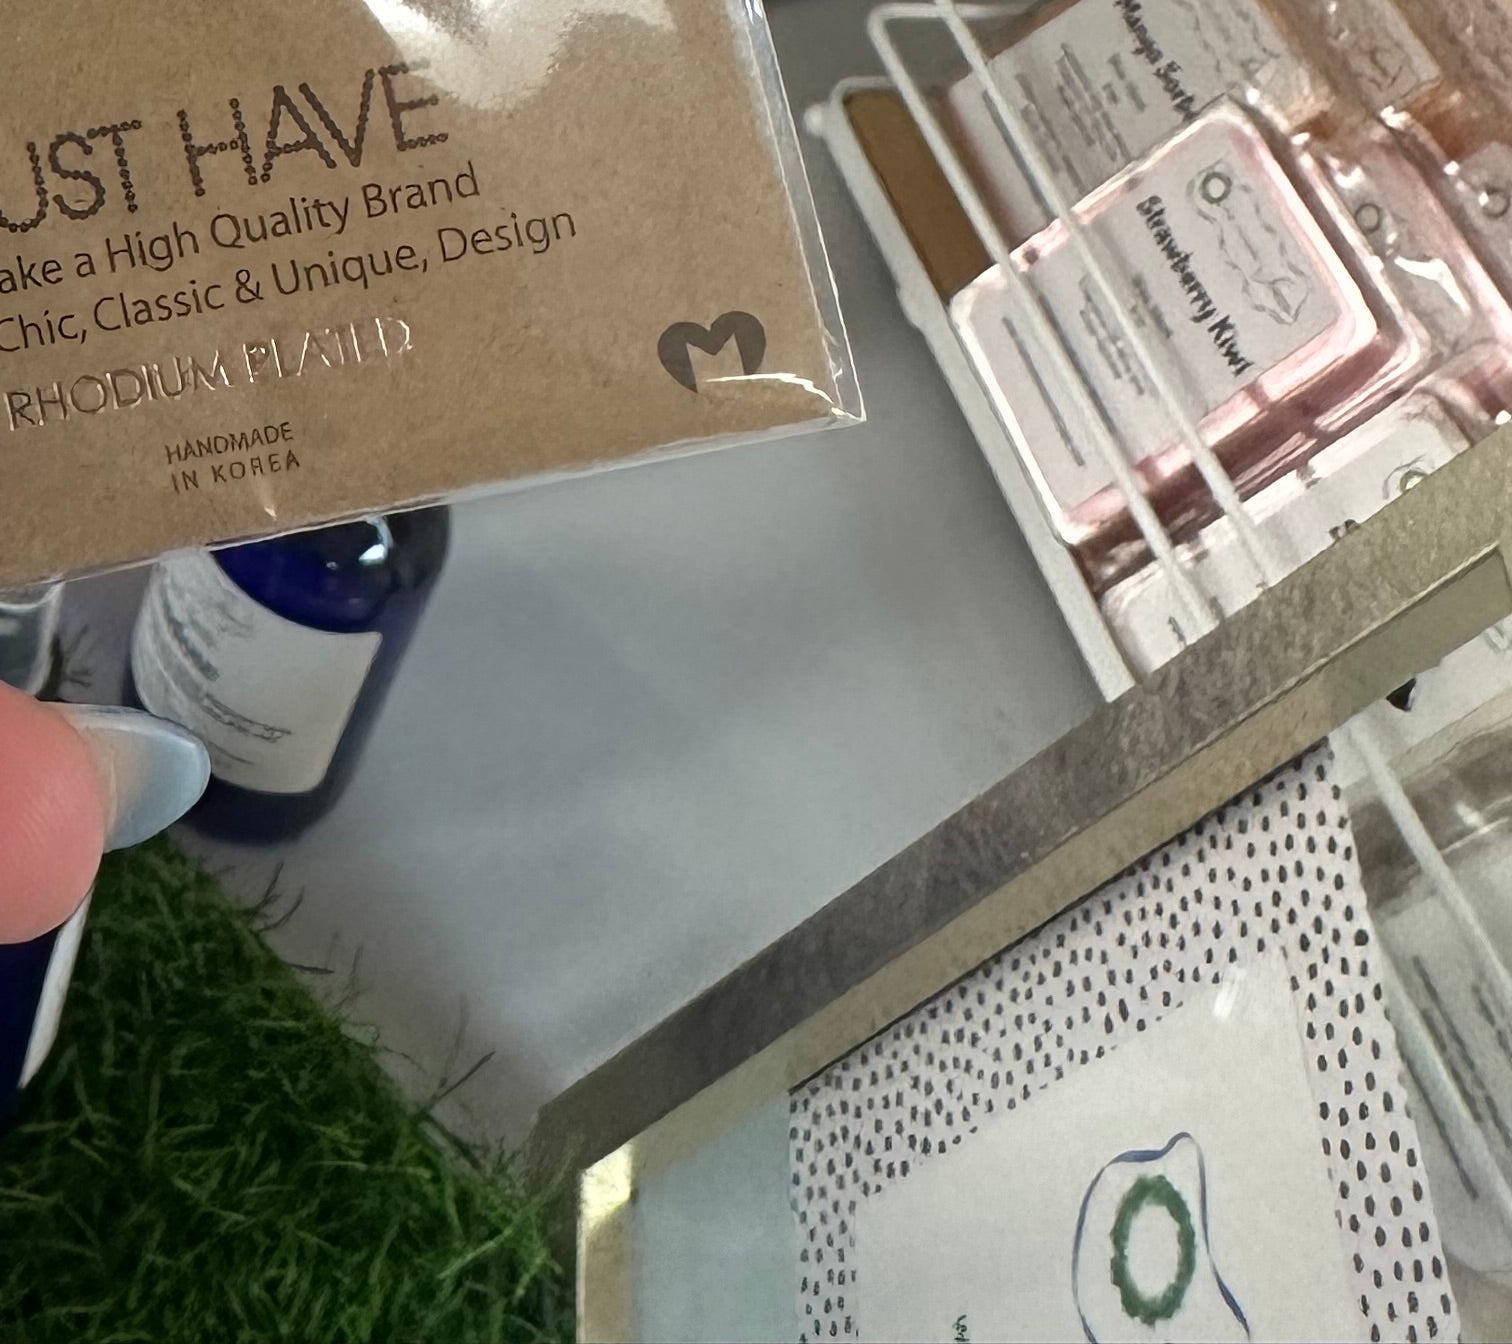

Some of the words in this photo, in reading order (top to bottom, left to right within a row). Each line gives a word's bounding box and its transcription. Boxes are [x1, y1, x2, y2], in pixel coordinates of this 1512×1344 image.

[177, 58, 449, 197] HAVE
[74, 252, 96, 278] a
[105, 221, 200, 272] High
[210, 197, 350, 249] Quality
[361, 160, 481, 218] Brand
[94, 279, 226, 331] Classic
[235, 268, 265, 305] &
[271, 244, 429, 295] Unique,
[438, 211, 577, 262] Design
[1136, 195, 1217, 324] Strawberry
[1207, 314, 1255, 378] Kiwi
[3, 348, 234, 431] RHODIUM
[165, 422, 296, 466] HANDMADE
[170, 470, 200, 494] IN
[213, 449, 301, 486] KOREA
